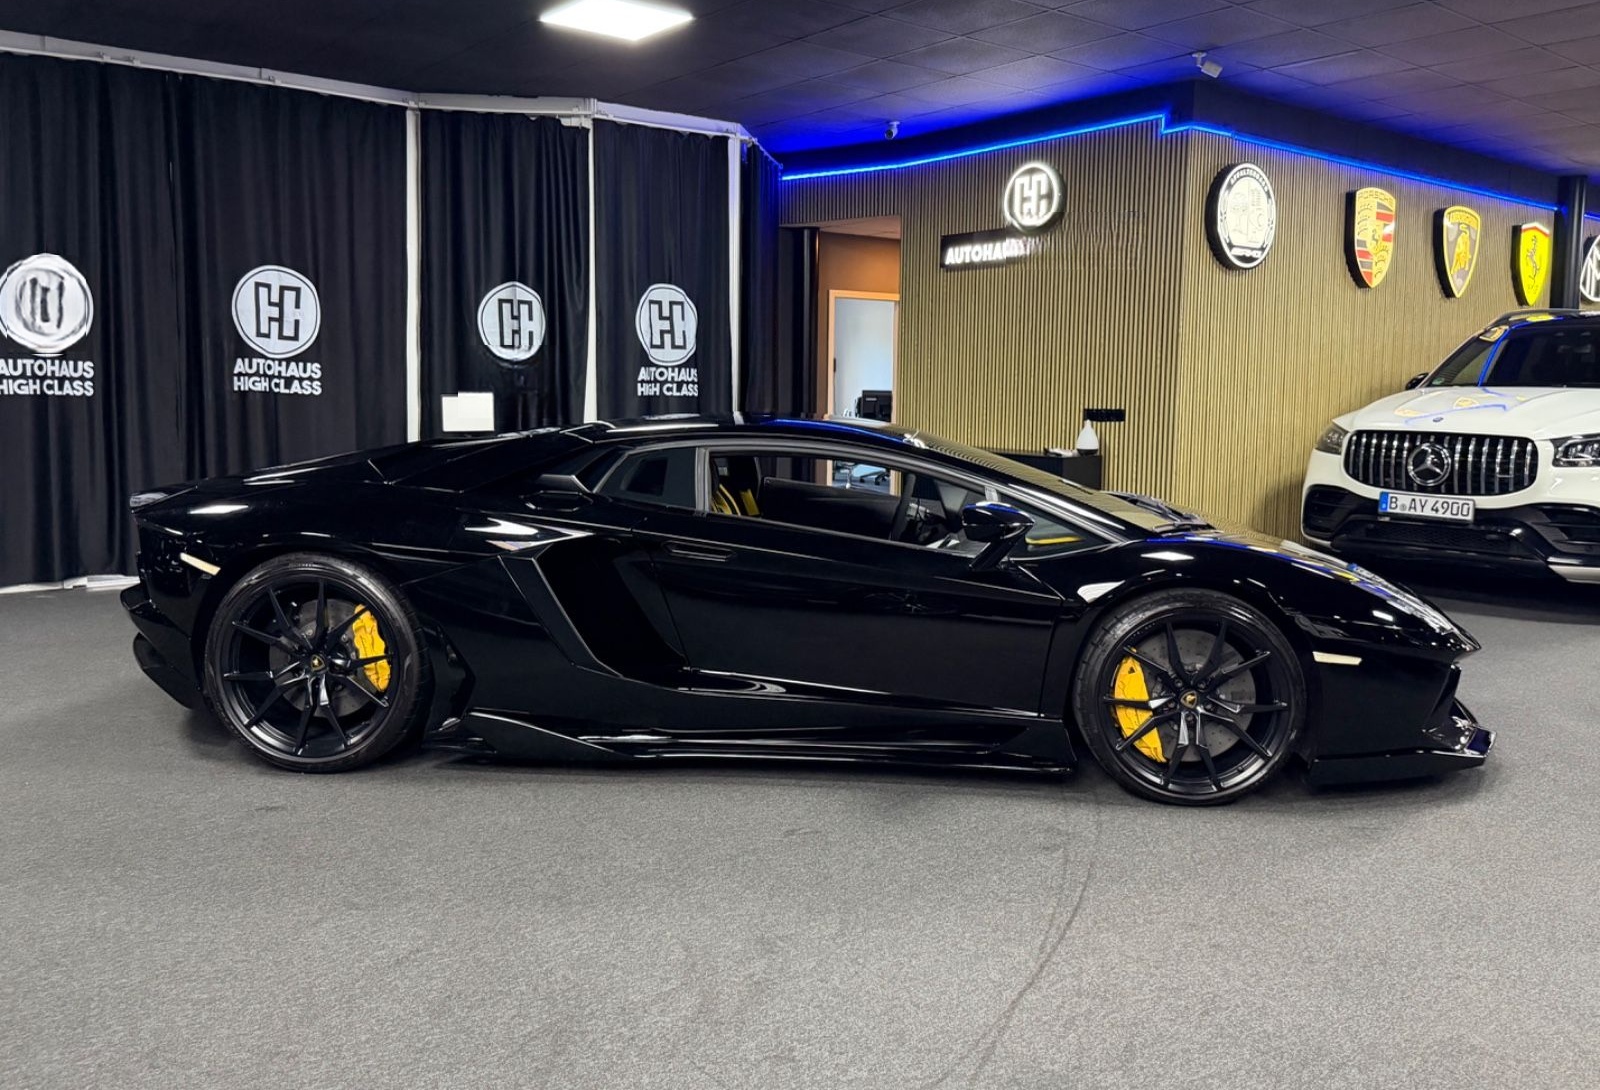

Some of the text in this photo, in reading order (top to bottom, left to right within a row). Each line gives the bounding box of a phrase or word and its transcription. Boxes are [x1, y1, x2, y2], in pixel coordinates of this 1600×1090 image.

[0, 358, 94, 379] AUTOHAUS
[233, 357, 322, 379] AUTOHAUS
[0, 378, 94, 397] HIGH CLASS
[233, 376, 322, 396] HIGH CLASS
[662, 383, 699, 397] CLASS
[1389, 496, 1470, 517] B AY 4900
